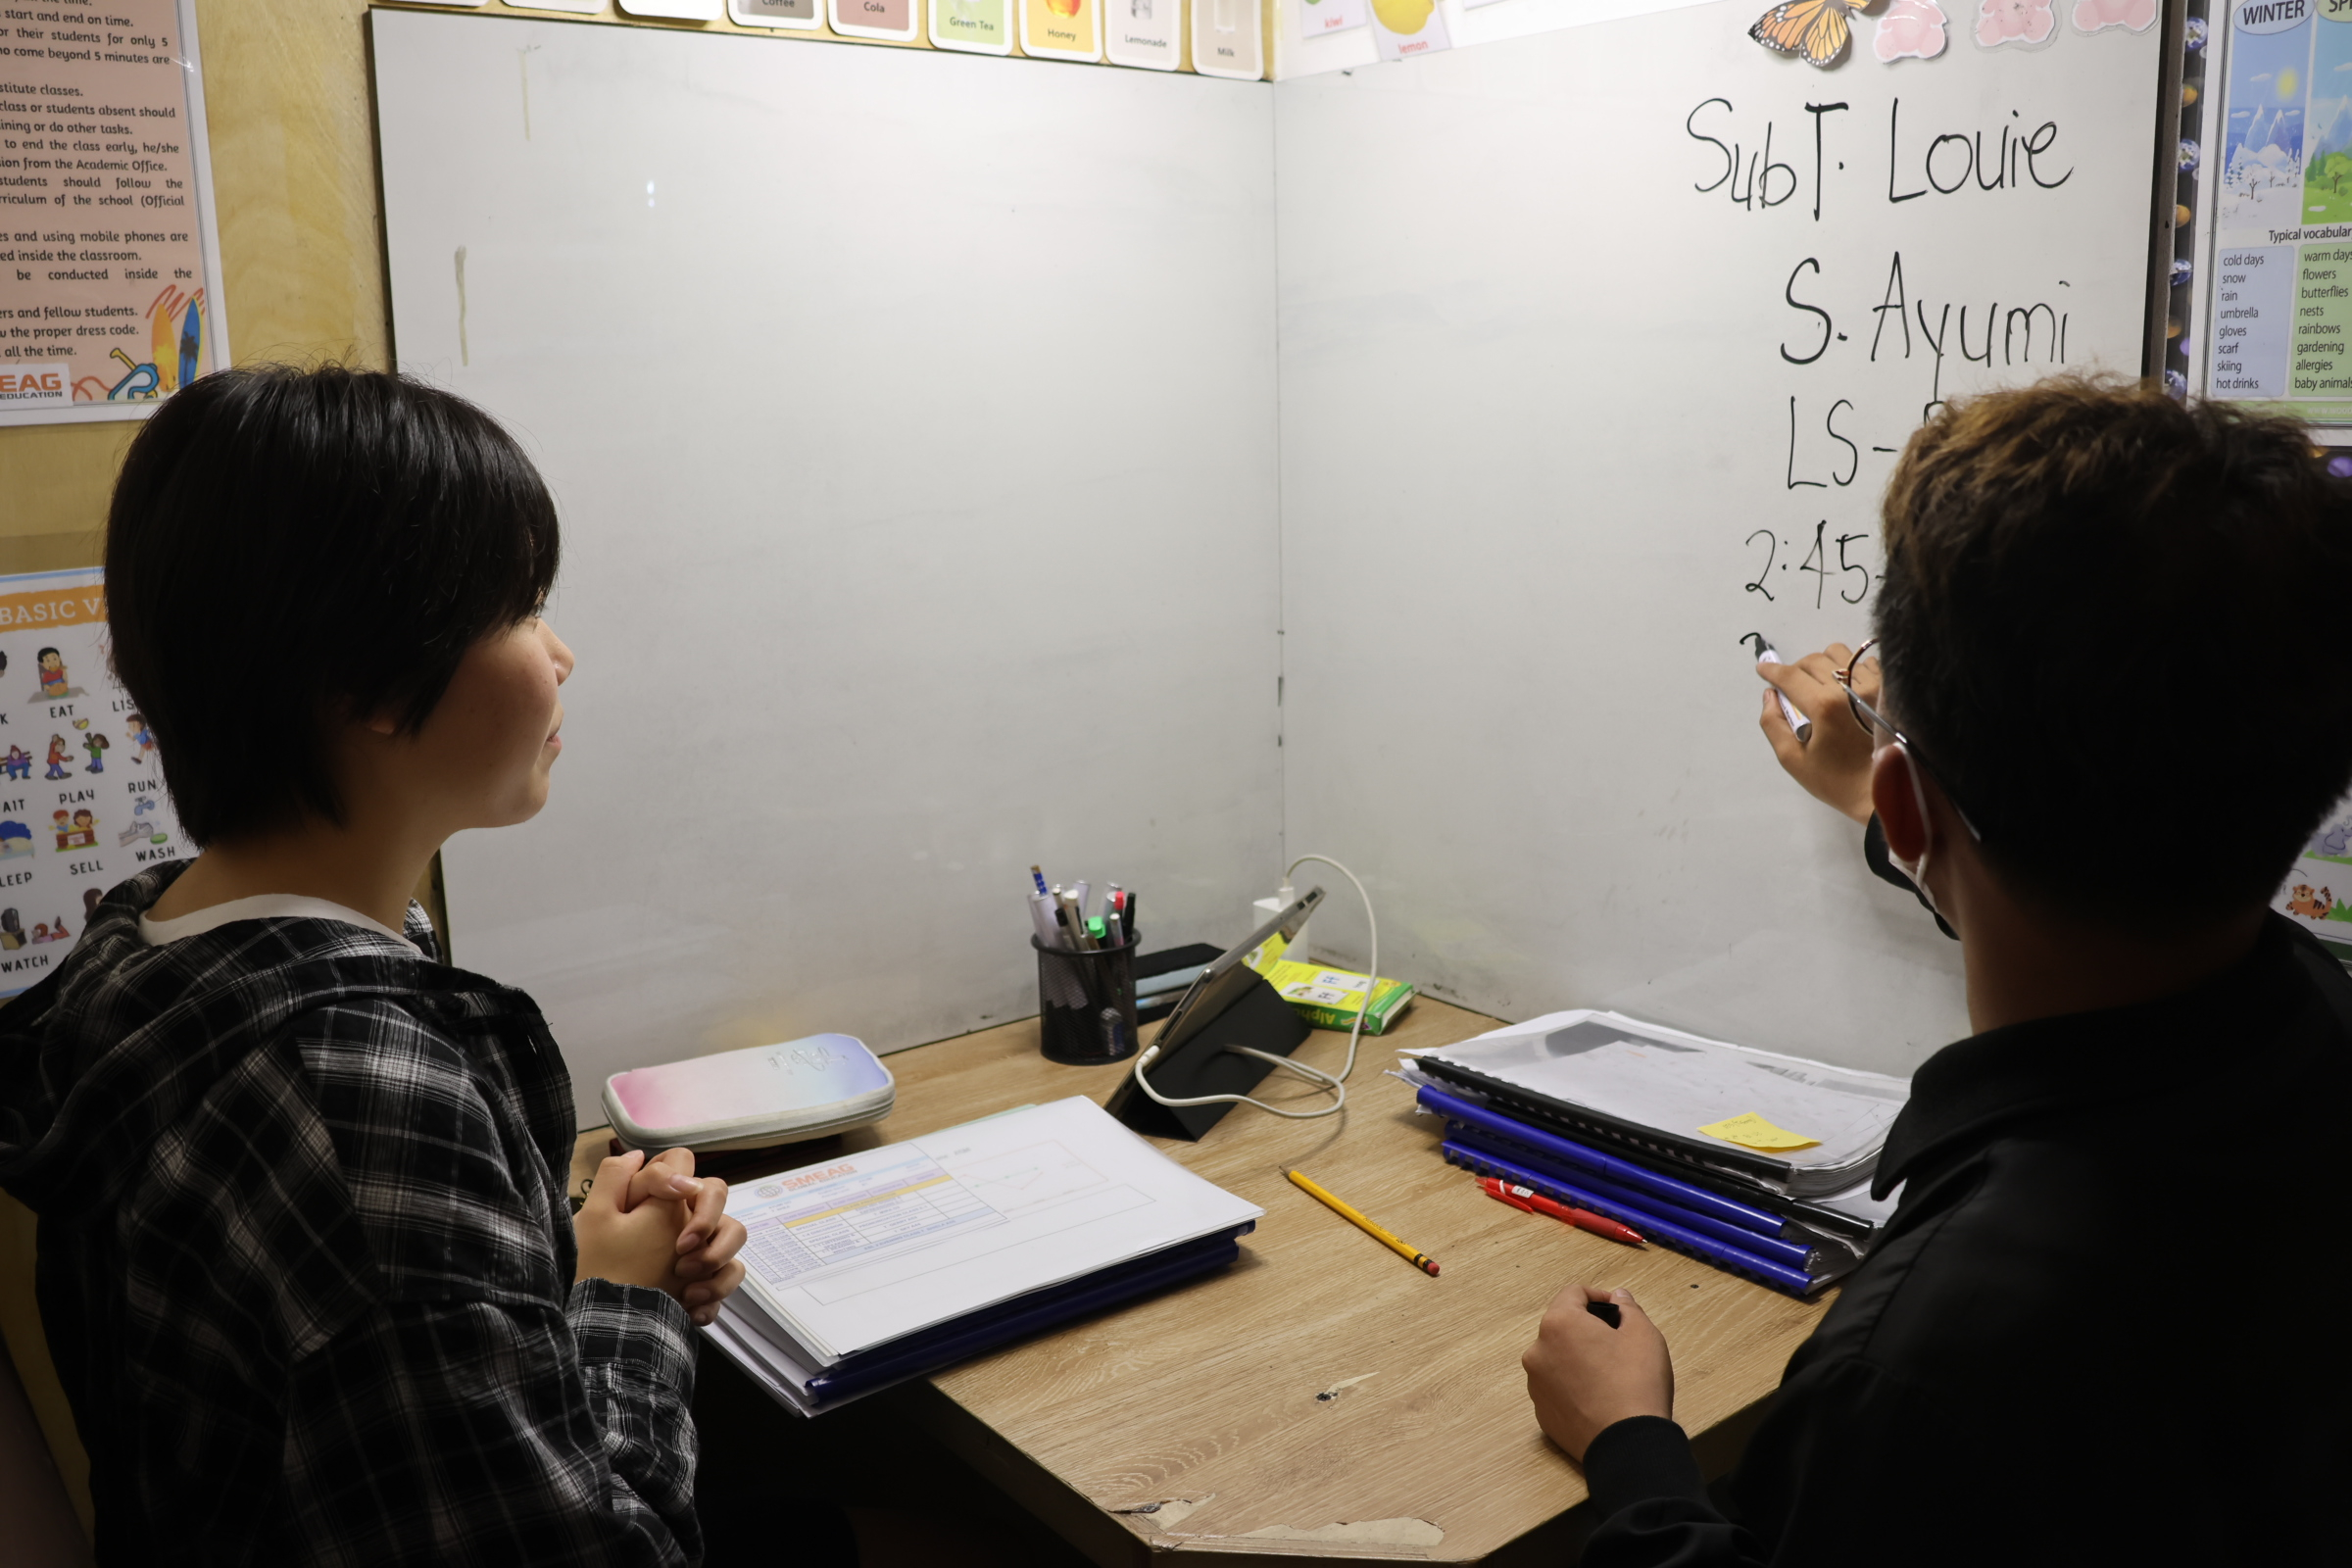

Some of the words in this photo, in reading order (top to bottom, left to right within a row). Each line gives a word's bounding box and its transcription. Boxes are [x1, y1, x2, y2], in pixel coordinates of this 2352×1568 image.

[863, 2, 885, 13] Cola
[2243, 0, 2305, 25] WINTER
[5, 9, 33, 21] start
[37, 12, 60, 23] and
[63, 14, 83, 24] end
[87, 17, 101, 25] on
[105, 15, 133, 27] time.
[950, 18, 977, 29] Green
[979, 21, 995, 31] Tea
[1325, 15, 1343, 29] kiwi
[17, 27, 44, 39] their
[51, 31, 100, 43] students
[108, 33, 123, 46] for
[130, 35, 155, 49] only
[162, 38, 168, 47] 5
[1048, 28, 1077, 42] Honey
[1125, 34, 1167, 48] Lemonade
[1217, 47, 1235, 58] Milk
[1398, 40, 1428, 55] lemon
[14, 48, 44, 58] come
[48, 47, 91, 62] beyond
[94, 51, 101, 61] 5
[105, 52, 149, 64] minutes
[152, 55, 170, 65] are
[40, 84, 83, 97] classes.
[46, 104, 95, 115] students
[99, 106, 136, 117] absent
[139, 107, 175, 118] should
[34, 123, 46, 132] or
[49, 122, 64, 132] do
[67, 122, 96, 134] other
[101, 124, 132, 135] tasks.
[5, 139, 17, 149] to
[23, 139, 43, 150] end
[49, 140, 68, 150] the
[74, 140, 100, 151] class
[105, 142, 137, 155] early,
[143, 142, 179, 154] he/she
[1888, 96, 2074, 204] Louie
[24, 157, 51, 172] from
[55, 158, 73, 170] the
[76, 160, 128, 171] Academic
[132, 160, 167, 173] Office.
[64, 177, 101, 187] should
[116, 177, 151, 190] follow
[167, 178, 182, 188] the
[54, 194, 66, 207] of
[74, 195, 91, 206] the
[99, 195, 133, 206] school
[140, 195, 184, 208] (Official
[15, 231, 37, 242] and
[43, 231, 75, 244] using
[80, 231, 120, 242] mobile
[124, 231, 166, 244] phones
[171, 233, 188, 242] are
[2269, 228, 2301, 244] Typical
[19, 251, 53, 262] inside
[57, 251, 75, 261] the
[80, 251, 141, 261] classroom.
[2224, 254, 2242, 267] cold
[2244, 254, 2264, 268] days
[2304, 251, 2330, 262] warm
[17, 270, 30, 280] be
[48, 270, 109, 280] conducted
[125, 269, 158, 279] inside
[174, 269, 192, 278] the
[2223, 273, 2246, 284] snow
[2303, 269, 2336, 280] flowers
[2222, 290, 2237, 301] rain
[2301, 286, 2349, 299] butterflies
[18, 307, 40, 318] and
[44, 307, 81, 320] fellow
[85, 307, 137, 318] students.
[2221, 307, 2259, 319] umbrella
[2300, 306, 2324, 317] nests
[11, 326, 29, 337] the
[34, 327, 72, 340] proper
[76, 324, 106, 336] dress
[110, 324, 138, 335] code.
[1871, 250, 2072, 402] Ayumi
[2219, 325, 2247, 339] gloves
[2298, 322, 2341, 335] rainbows
[5, 346, 21, 357] all
[24, 346, 43, 357] the
[47, 345, 76, 356] time.
[2219, 343, 2238, 355] scarf
[2297, 342, 2344, 356] gardening
[2217, 361, 2242, 373] skiing
[2296, 360, 2332, 373] allergies
[2216, 378, 2231, 389] hot
[2232, 377, 2259, 389] drinks
[2295, 377, 2318, 392] baby
[50, 705, 74, 718] EAT
[128, 780, 157, 794] RUN
[59, 790, 95, 805] PLAY
[135, 846, 175, 861] WASH
[70, 860, 104, 875] SELL
[1, 955, 49, 973] WATCH
[781, 1163, 855, 1190] SMEAG
